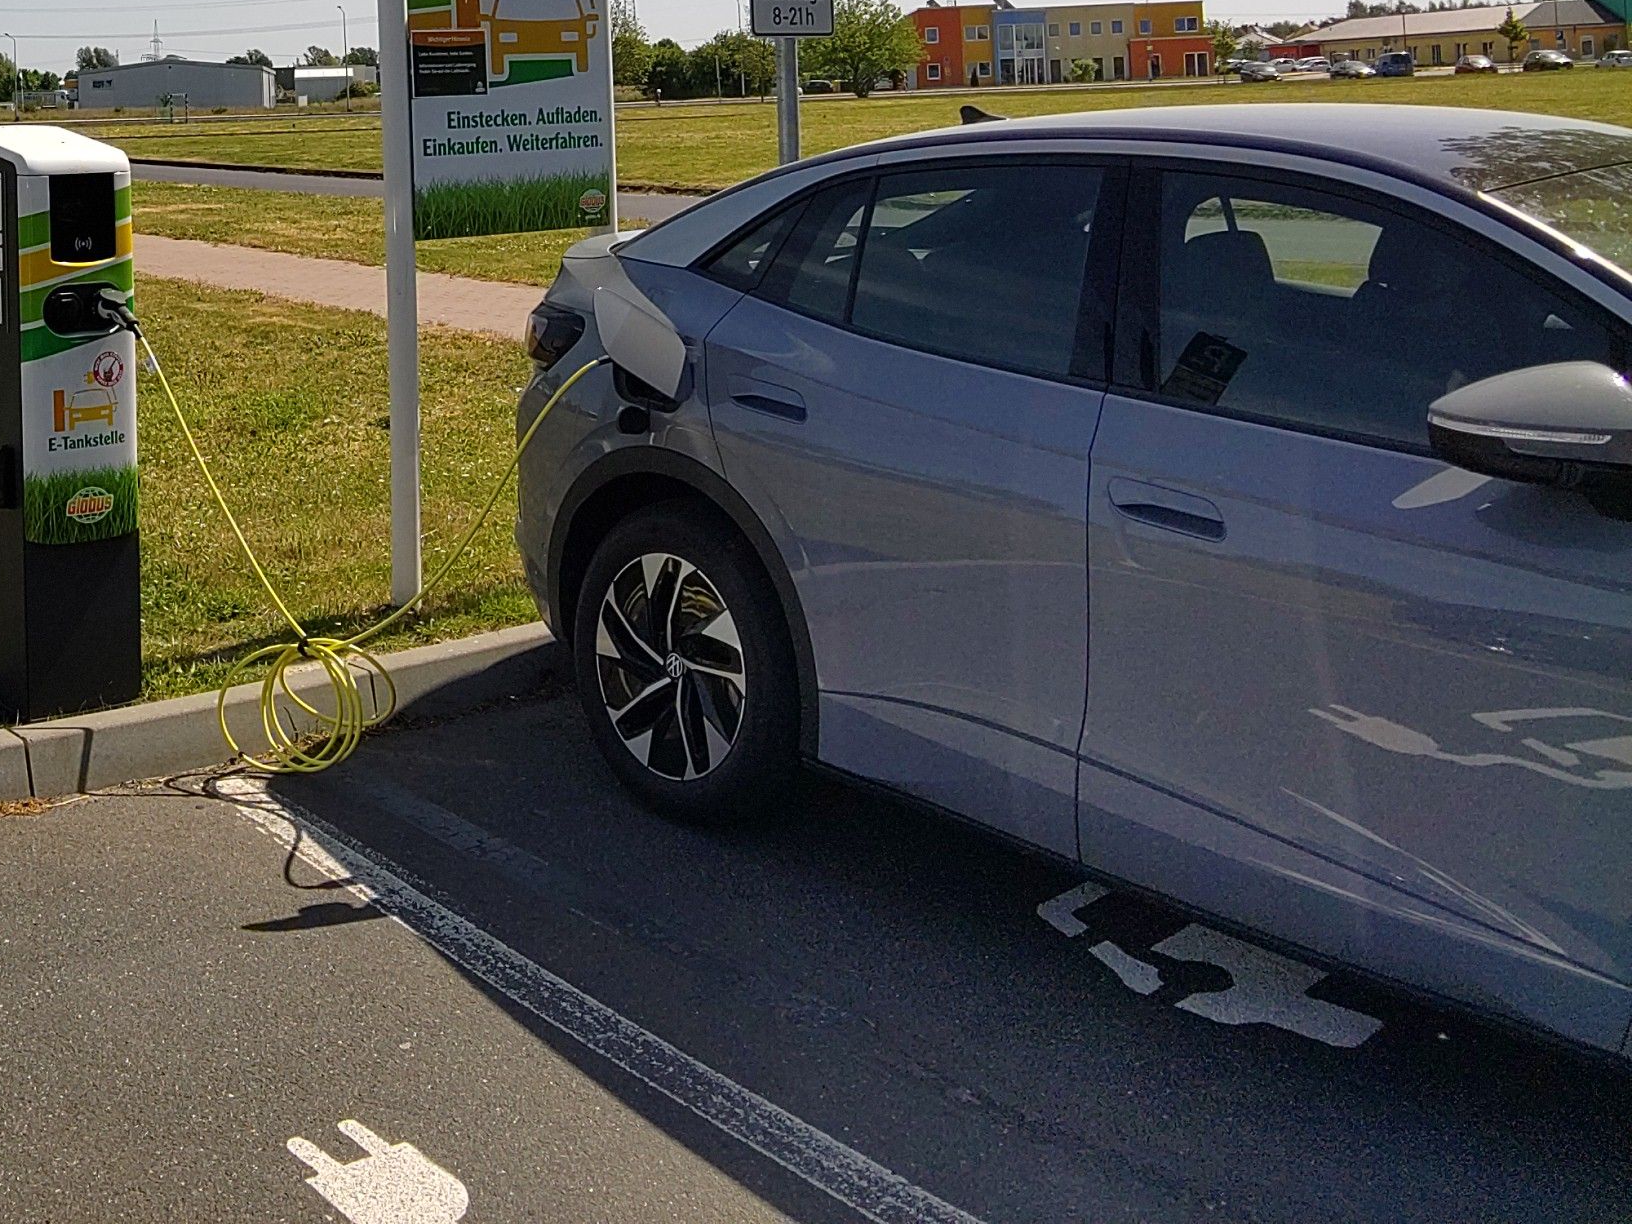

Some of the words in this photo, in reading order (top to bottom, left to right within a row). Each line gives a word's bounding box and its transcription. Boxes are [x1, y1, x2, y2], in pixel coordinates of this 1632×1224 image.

[447, 108, 532, 129] Einstecken.
[536, 106, 603, 125] Aufladen.
[423, 135, 503, 157] Einkaufen.
[506, 131, 604, 153] Weiterfahren.
[48, 430, 126, 452] E-Tankstelle
